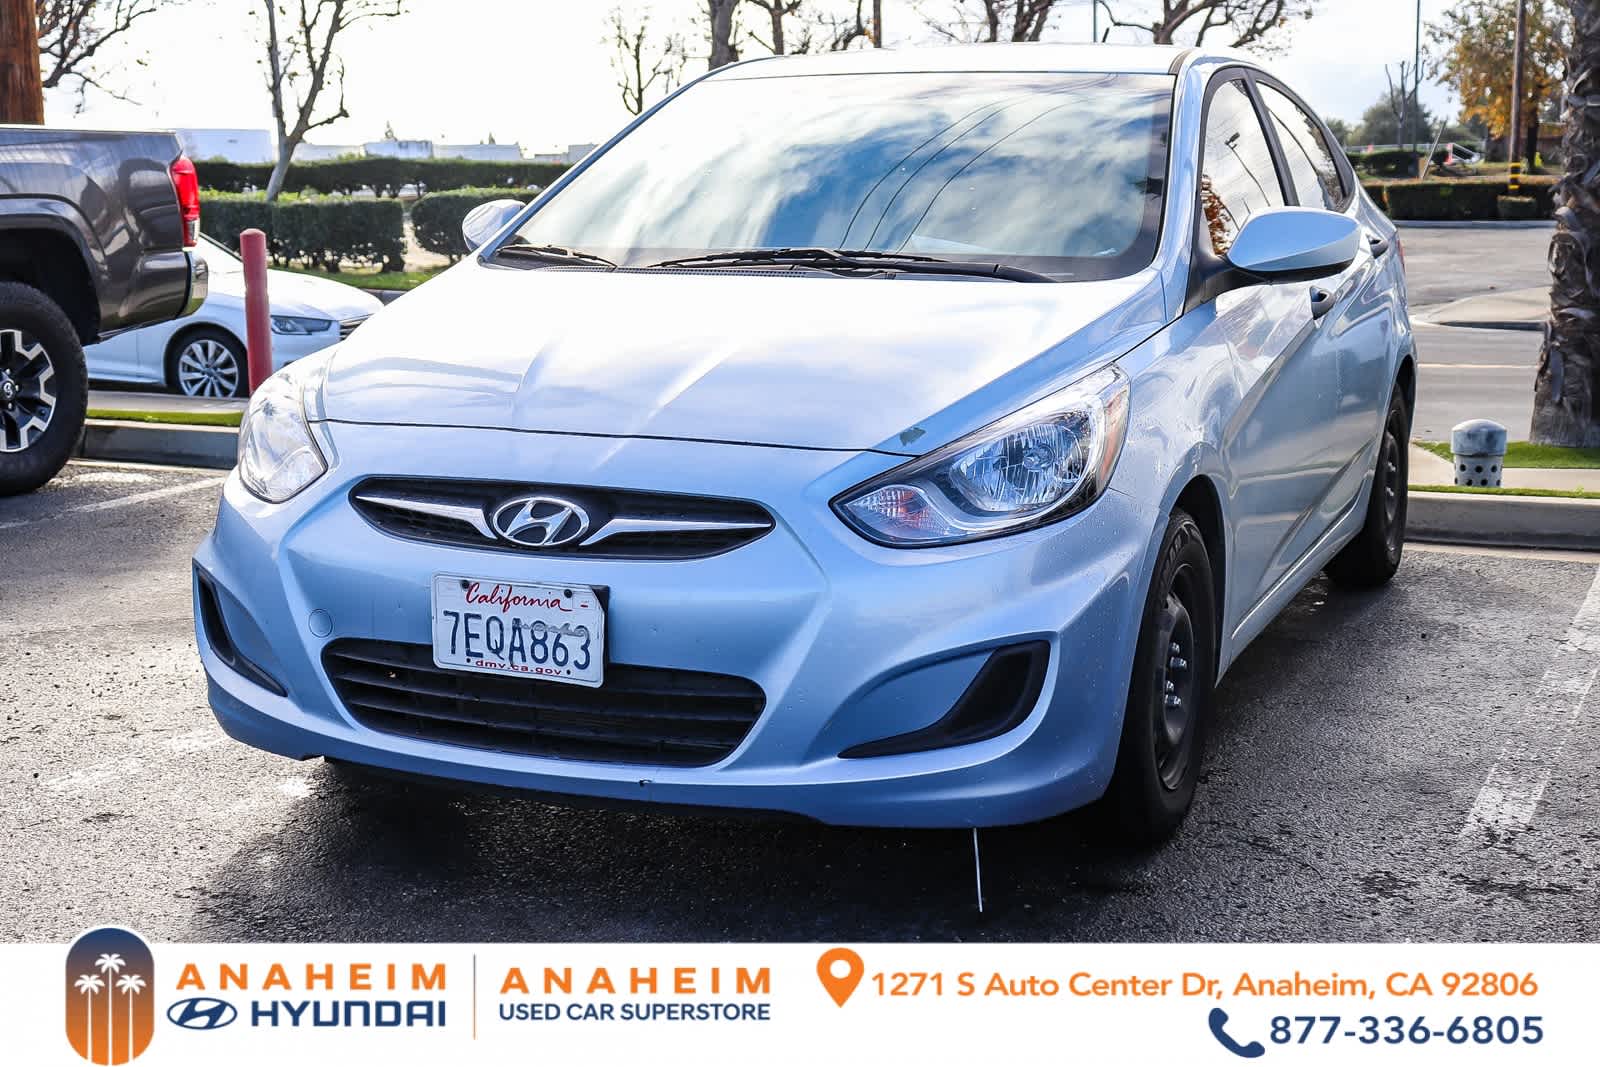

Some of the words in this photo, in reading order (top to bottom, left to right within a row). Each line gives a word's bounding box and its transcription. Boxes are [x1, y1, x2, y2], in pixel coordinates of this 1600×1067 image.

[465, 582, 572, 613] California
[443, 610, 591, 670] 7EQA863
[475, 659, 562, 676] dmv.ca.gov
